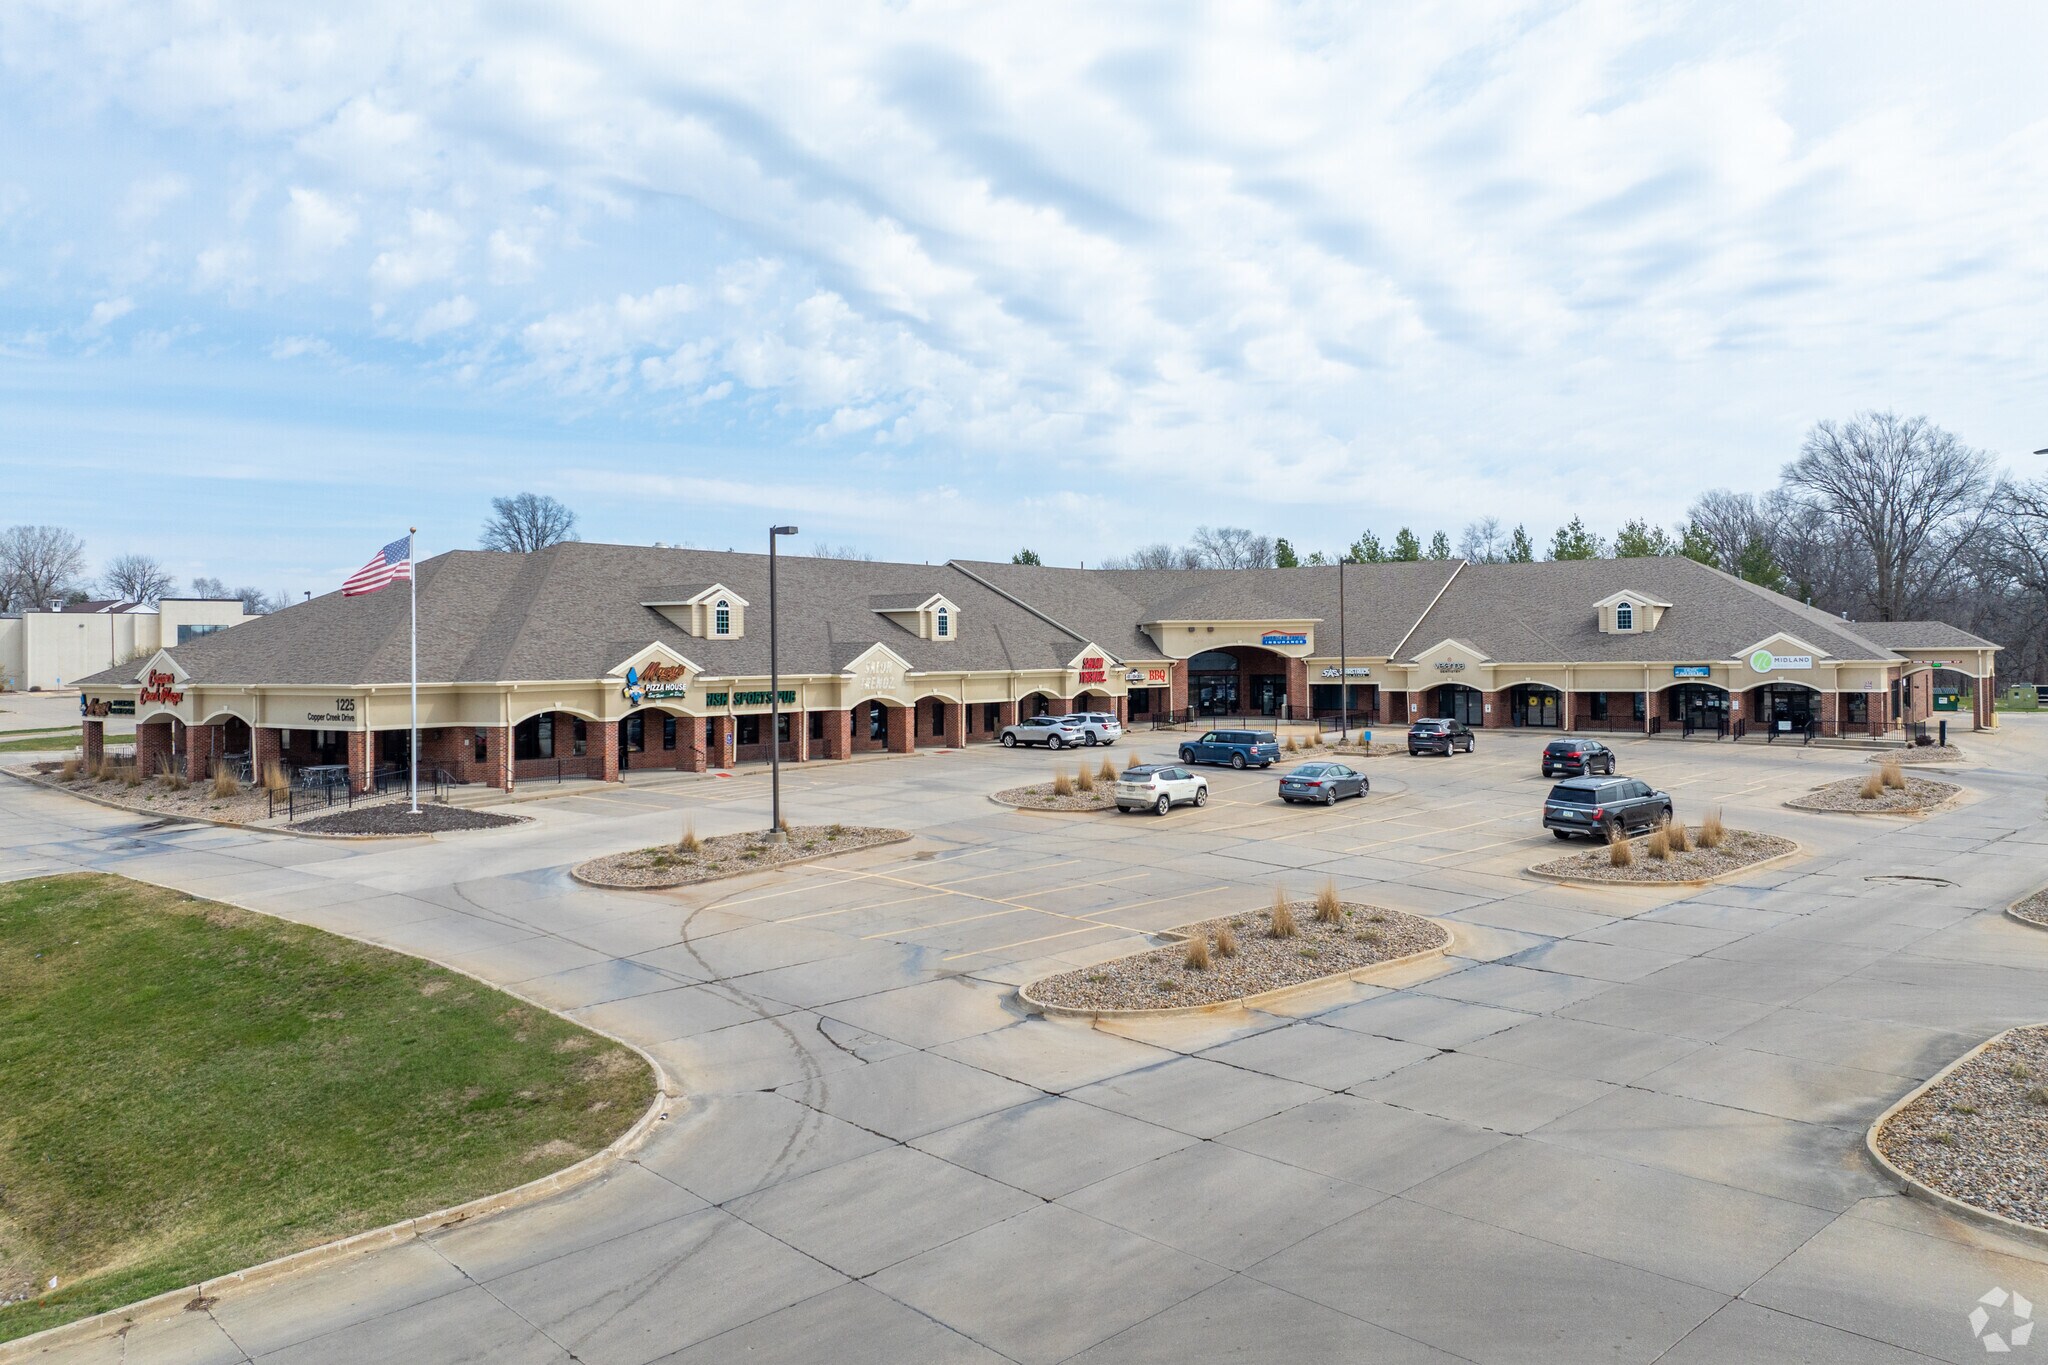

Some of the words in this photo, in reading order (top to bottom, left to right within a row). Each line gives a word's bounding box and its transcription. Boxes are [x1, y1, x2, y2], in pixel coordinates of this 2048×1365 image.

[1149, 669, 1166, 683] BBQ
[645, 684, 665, 692] PIZZA
[336, 698, 355, 711] 1225
[706, 693, 729, 707] RISH
[733, 691, 773, 705] SPORTS
[777, 691, 796, 703] PUB
[307, 712, 325, 722] Copper
[326, 713, 340, 721] Creek
[341, 713, 355, 722] Drive
